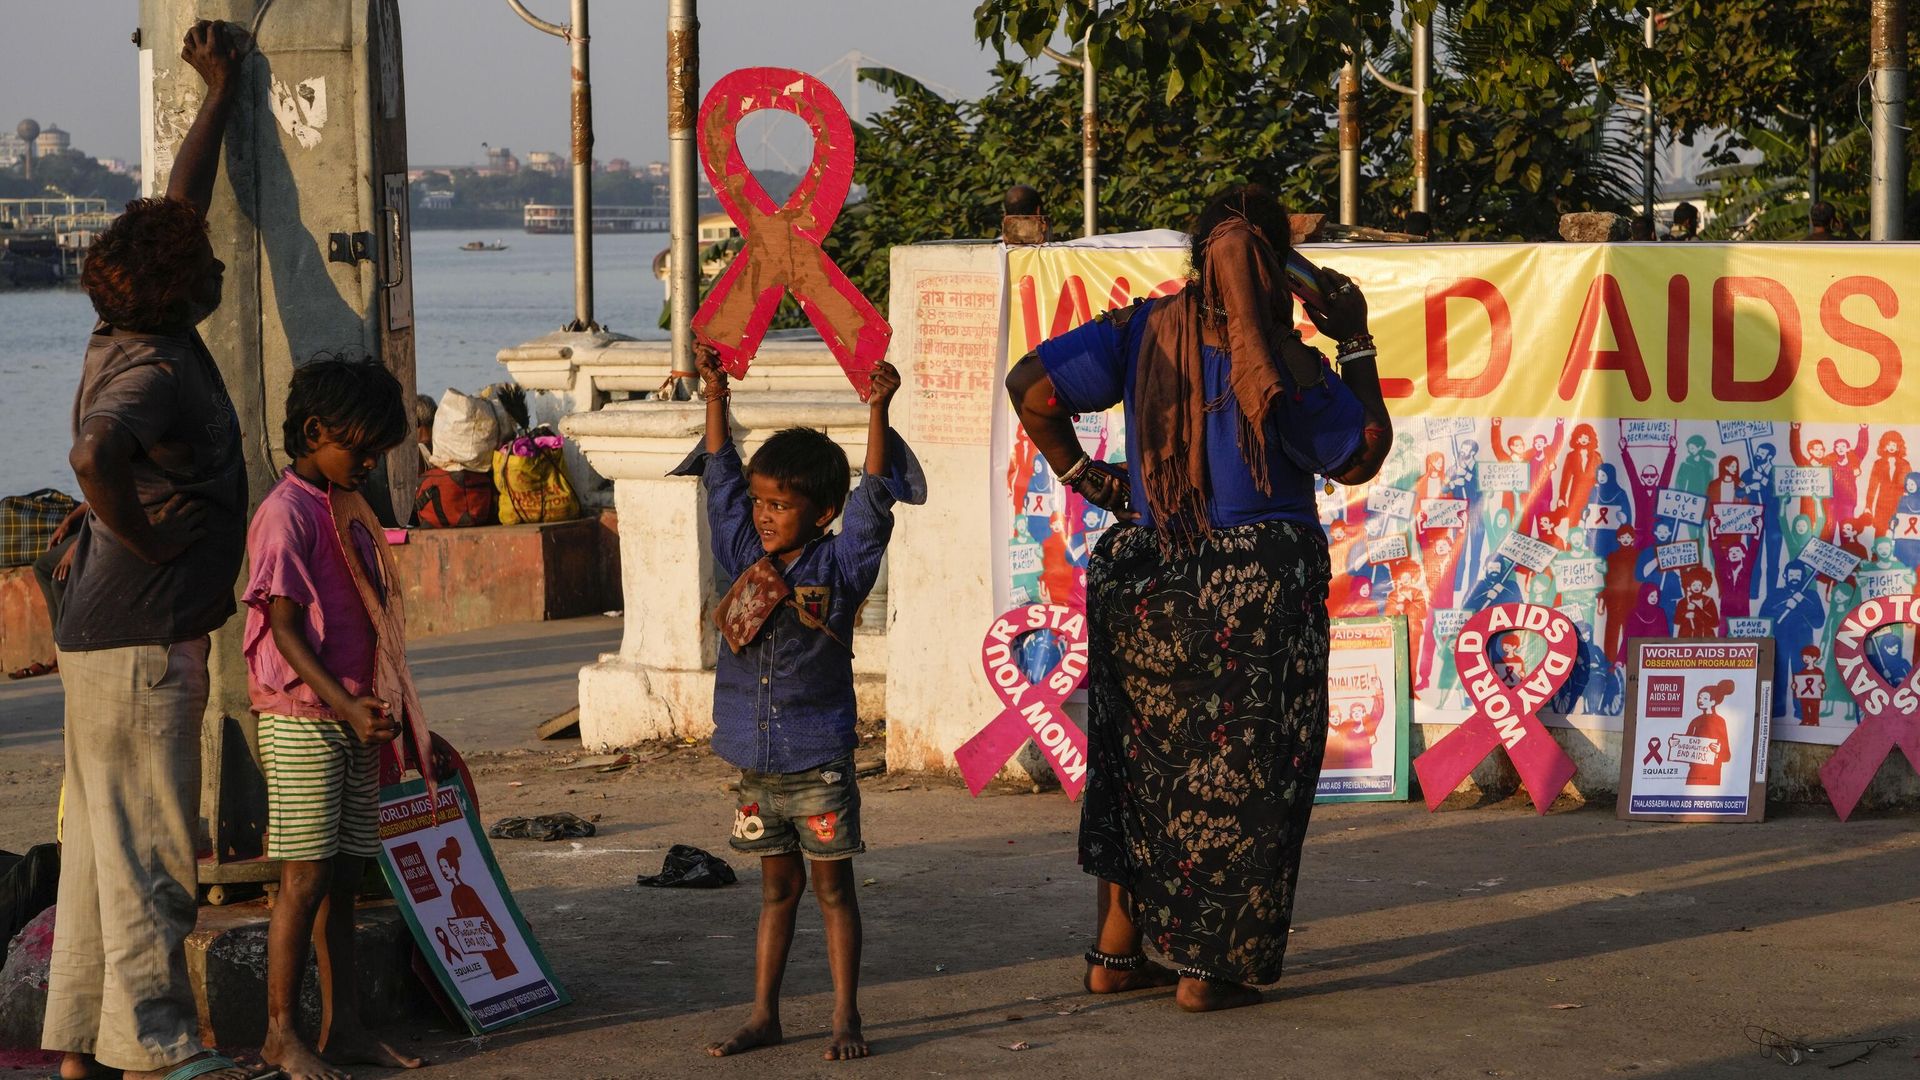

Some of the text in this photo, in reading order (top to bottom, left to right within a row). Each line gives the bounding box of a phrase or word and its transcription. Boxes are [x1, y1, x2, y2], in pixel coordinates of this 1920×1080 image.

[919, 289, 945, 306] রাম
[1557, 273, 1903, 407] AIDS
[1628, 421, 1670, 432] SAVE LIVES:
[1721, 420, 1746, 431] HUMAN
[1723, 429, 1746, 439] RIGHTS
[1487, 464, 1520, 474] SCHOOL
[1784, 469, 1820, 478] SCHOOL
[1665, 492, 1698, 505] LOVE
[1428, 502, 1442, 512] LET
[1722, 507, 1738, 517] LET
[1663, 507, 1696, 521] LOVE
[1441, 518, 1459, 526] LEAD
[1735, 523, 1753, 532] LEAD
[1012, 547, 1033, 560] FIGHT
[1371, 547, 1406, 562] END FEES
[1012, 560, 1034, 571] RACISM
[1661, 553, 1697, 567] END FEES
[1562, 562, 1592, 577] FIGHT
[1563, 575, 1594, 585] RACISM
[1868, 573, 1901, 588] FIGHT
[1868, 586, 1903, 598] RACISM
[1736, 620, 1762, 628] LEAVE
[1836, 600, 1883, 650] NO
[1334, 628, 1389, 640] AIDS DAY
[1645, 648, 1754, 658] WORLD AIDS DAY
[985, 618, 1030, 706] YOUR
[1645, 659, 1698, 668] OBSERVATION
[1699, 659, 1736, 668] PROGRAM
[1328, 673, 1370, 690] QUALIZE!
[1458, 604, 1572, 750] WORLD AIDS DAY
[1653, 683, 1678, 692] WORLD
[1836, 655, 1890, 715] SAY
[1649, 693, 1681, 701] AIDS DAY
[1020, 700, 1087, 783] KNOW
[1677, 750, 1690, 758] END
[411, 798, 433, 815] AIDS
[1633, 800, 1745, 809] THALASSAEMIA AND AIDS PREVENTION SOCIETY
[446, 807, 460, 818] 2022
[401, 853, 421, 868] WORLD
[404, 865, 428, 880] AIDS DAY
[454, 962, 482, 977] EQUALIZE
